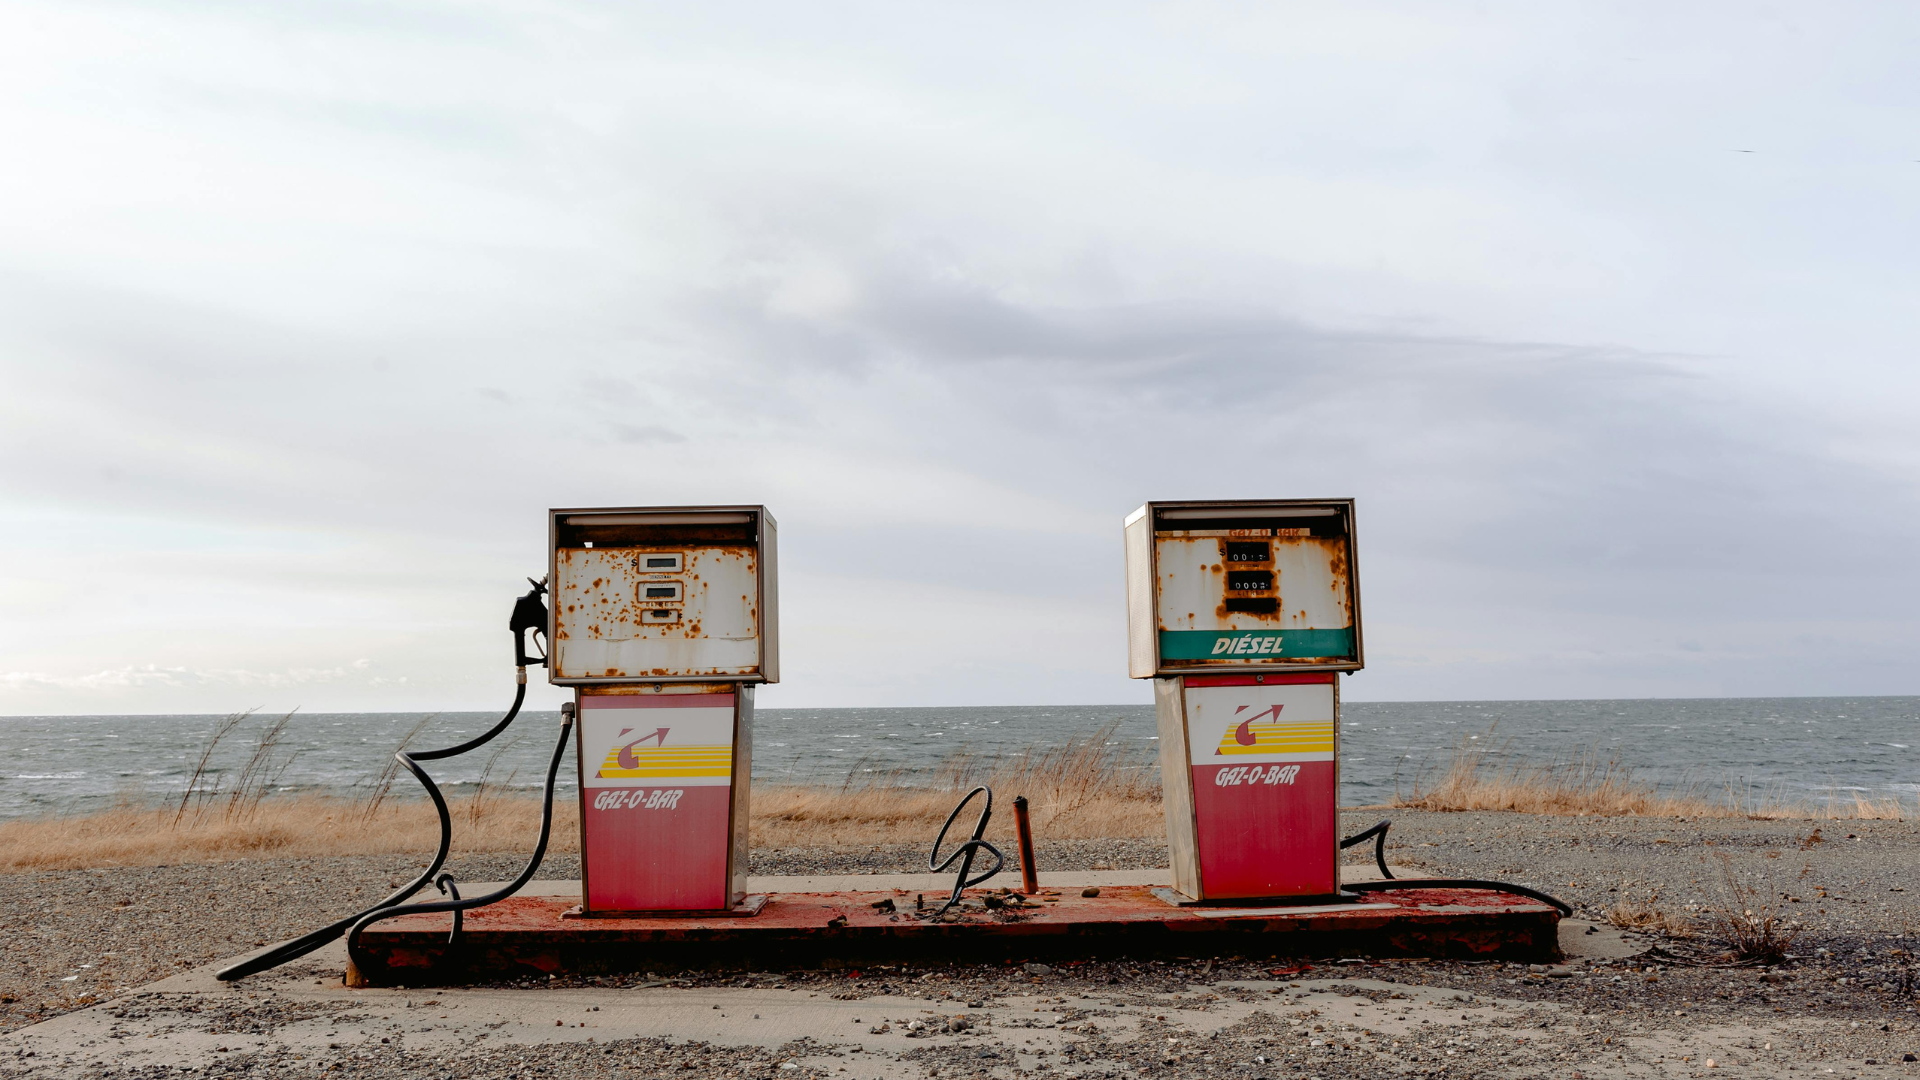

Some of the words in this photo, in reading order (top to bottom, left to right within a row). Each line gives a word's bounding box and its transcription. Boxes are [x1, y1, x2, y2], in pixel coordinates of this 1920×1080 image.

[1211, 634, 1284, 655] DIÉSEL
[1215, 765, 1301, 787] GAZ-O-BAR
[594, 789, 684, 811] GAZ-O-BAR
